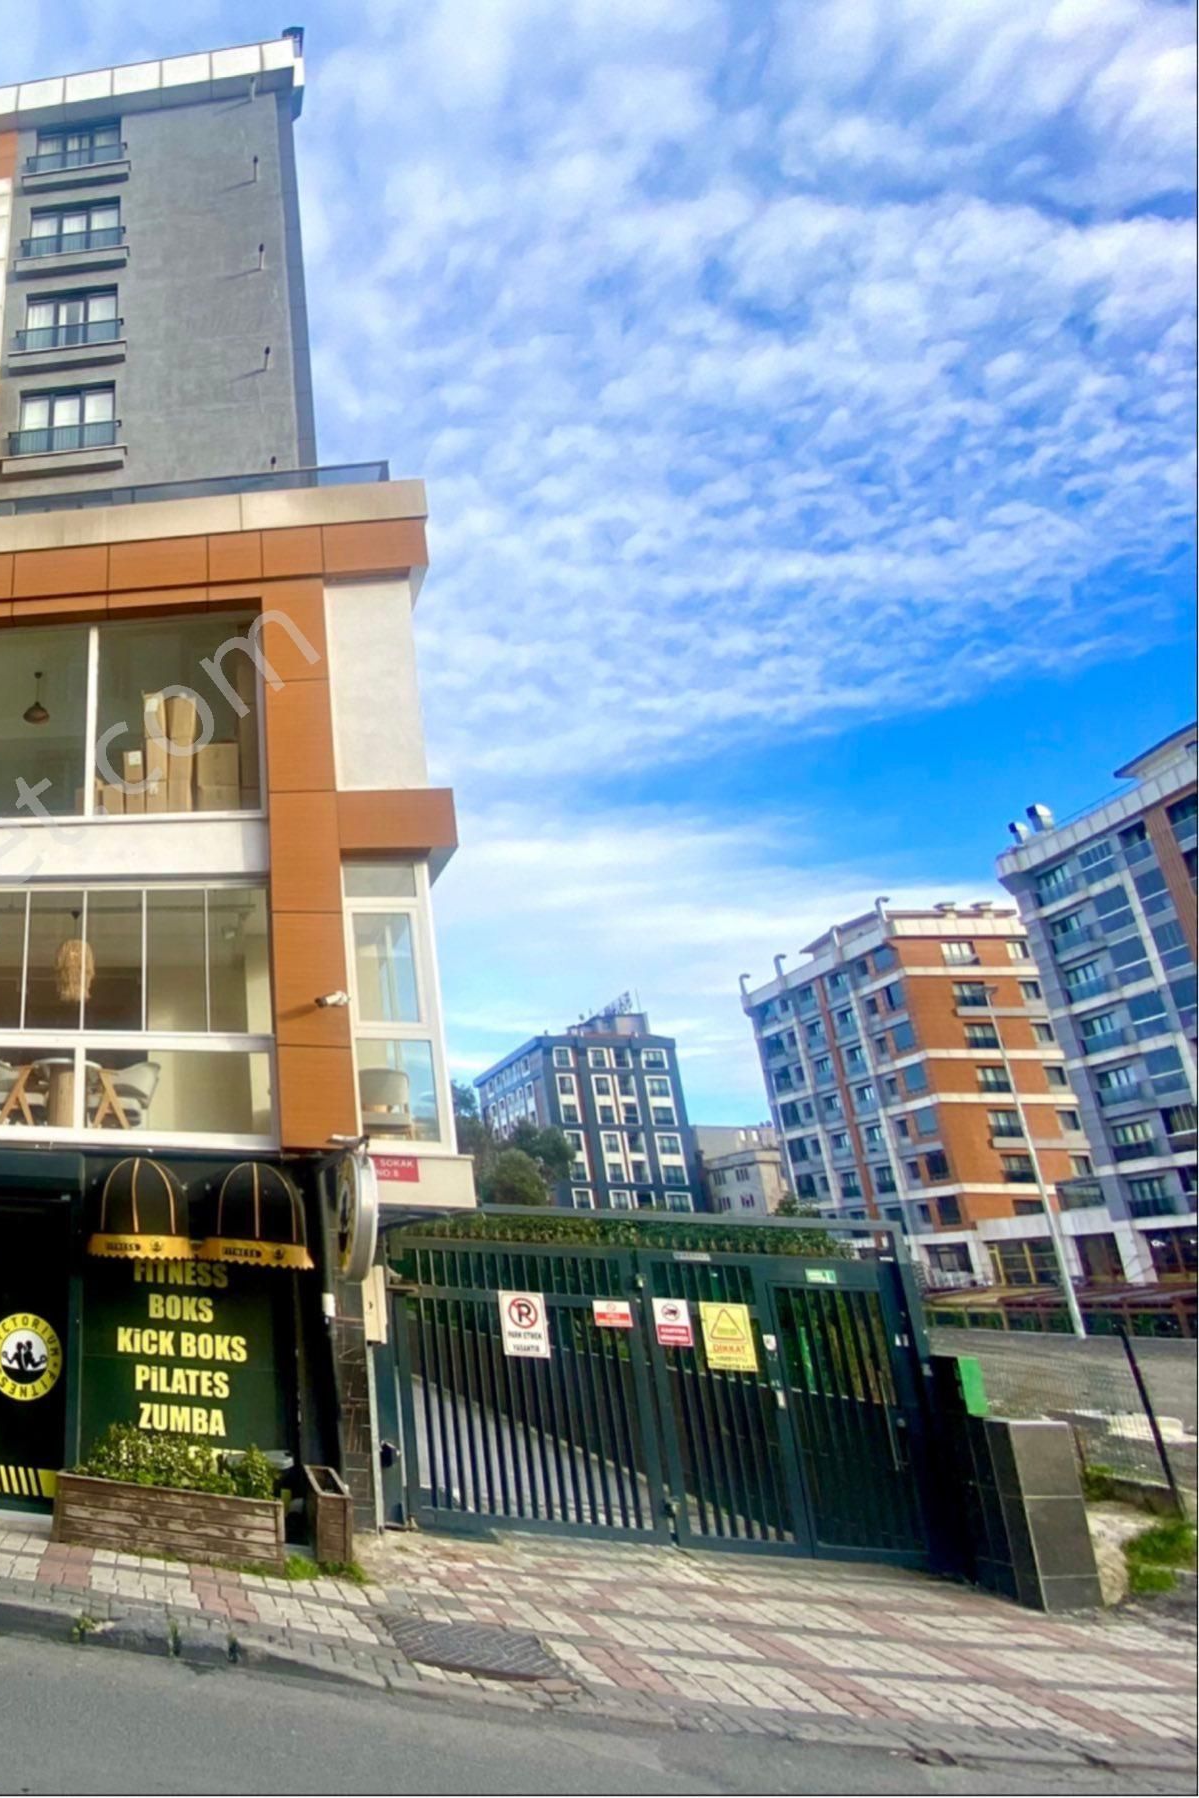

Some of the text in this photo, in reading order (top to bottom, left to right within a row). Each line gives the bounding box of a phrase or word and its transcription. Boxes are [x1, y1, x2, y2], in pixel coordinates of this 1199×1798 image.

[133, 1260, 229, 1288] FITNESS
[148, 1293, 214, 1323] BOKS
[180, 1331, 248, 1363] BOKS
[138, 1402, 227, 1437] ZUMBA
